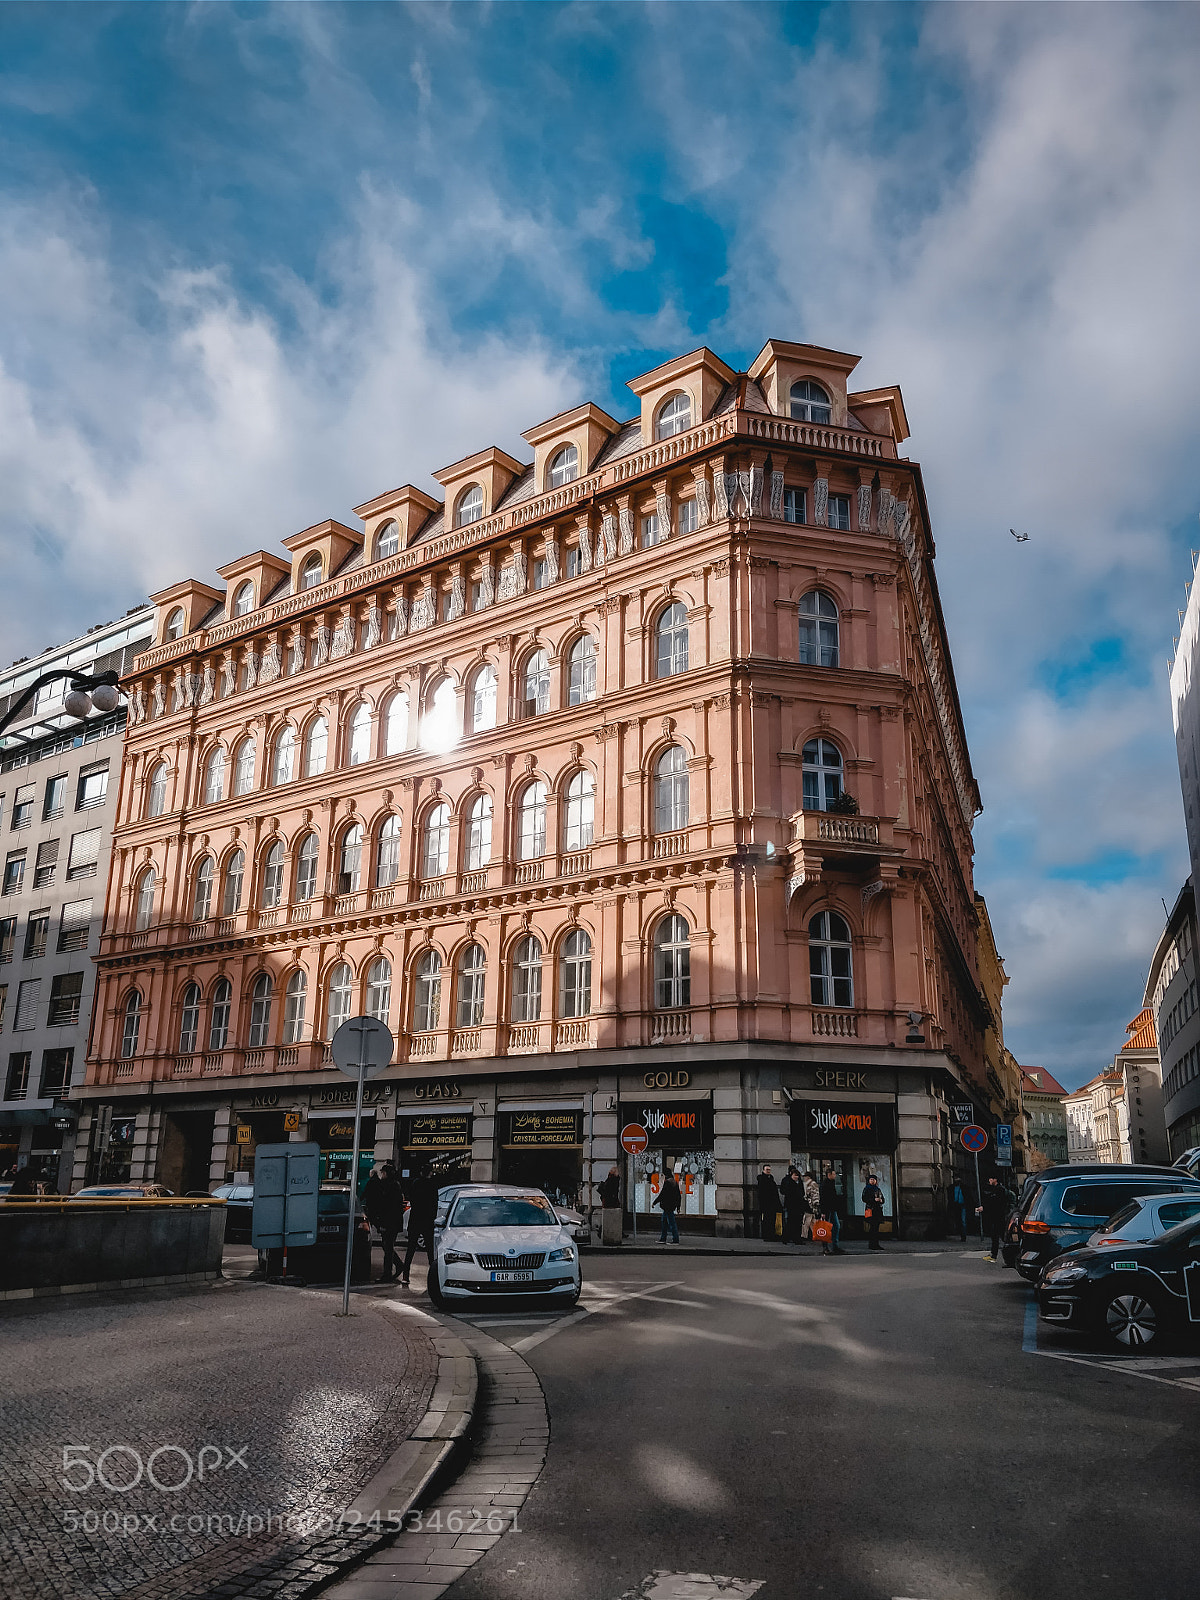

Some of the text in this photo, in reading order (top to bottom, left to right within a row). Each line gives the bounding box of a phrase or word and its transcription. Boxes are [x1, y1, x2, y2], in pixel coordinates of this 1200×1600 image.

[643, 1070, 689, 1088] GOLD
[815, 1067, 868, 1088] ŠPERK
[414, 1083, 460, 1098] GLASS
[1131, 1065, 1143, 1117] HOTEL
[440, 1116, 467, 1125] BOHEMIA
[545, 1115, 574, 1124] BOHEMIA
[642, 1108, 696, 1134] Styleavenue
[810, 1108, 872, 1134] Styleavenue
[651, 1173, 694, 1194] SE
[496, 1273, 509, 1281] 6AR
